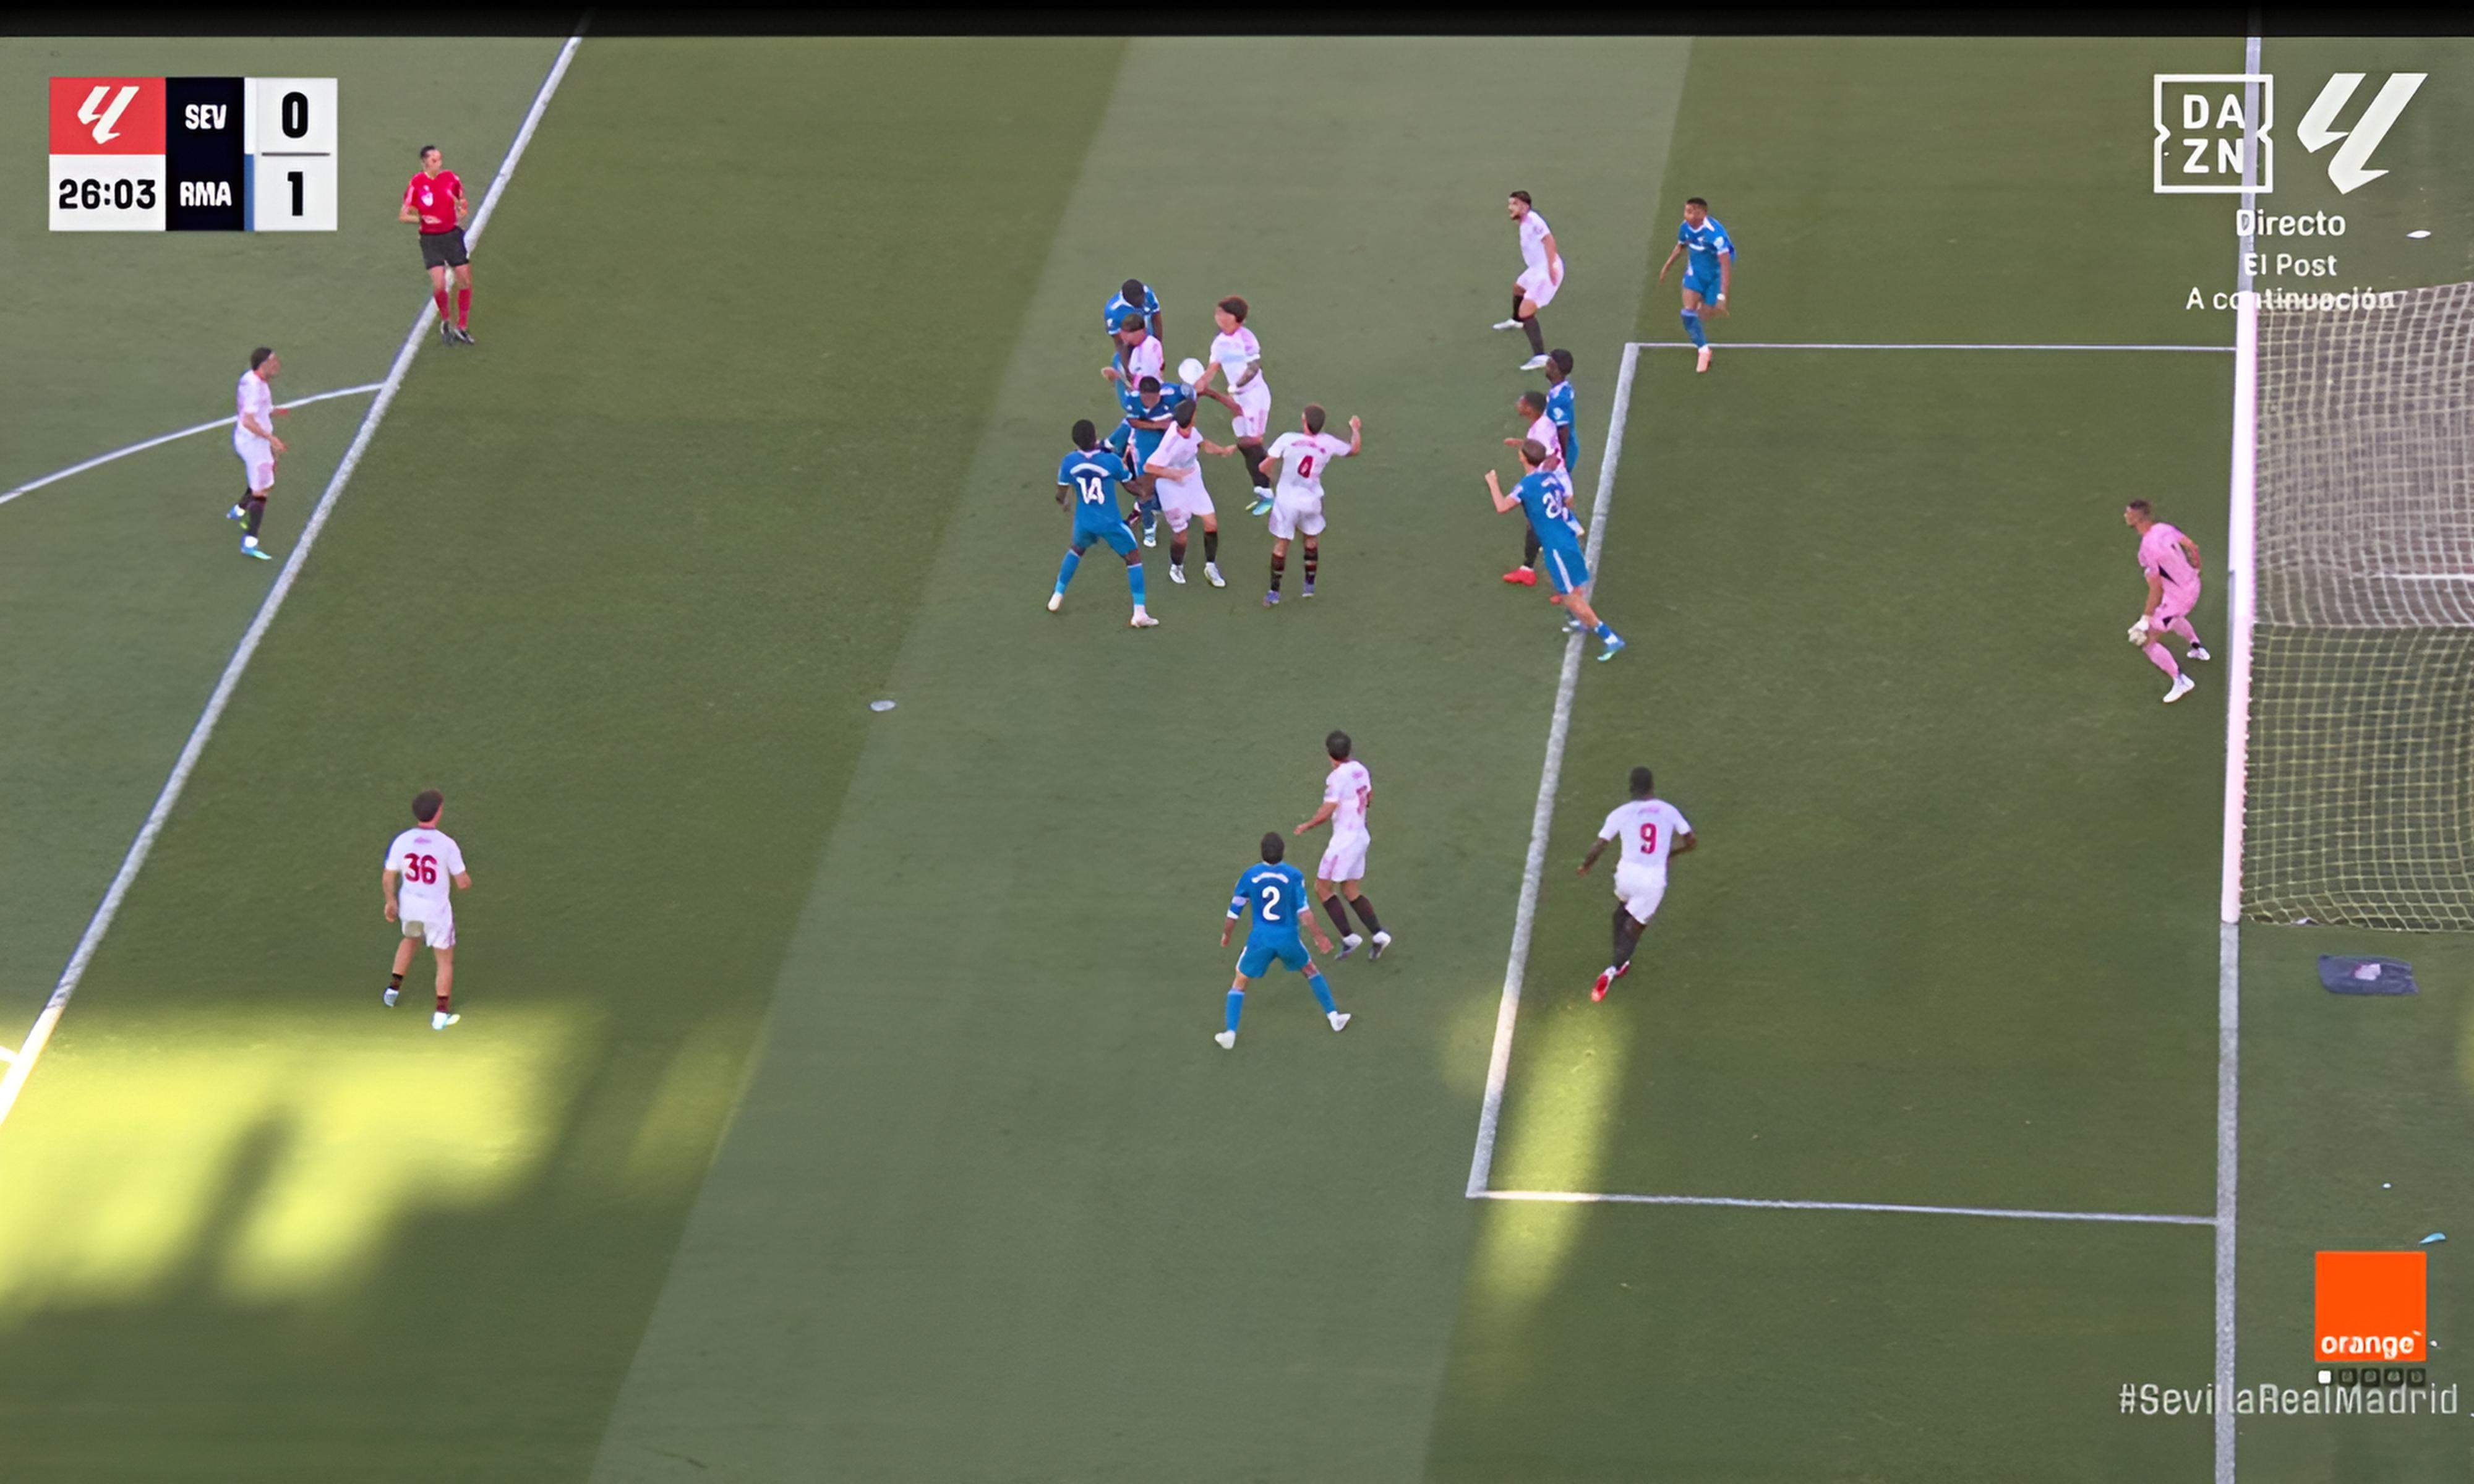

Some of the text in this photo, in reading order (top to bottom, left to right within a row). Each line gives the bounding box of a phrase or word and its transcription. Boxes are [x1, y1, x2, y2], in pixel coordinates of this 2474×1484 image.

[1076, 476, 1105, 505] 14
[1640, 822, 1658, 855] 9
[403, 852, 438, 885] 36
[1261, 885, 1281, 921] 2
